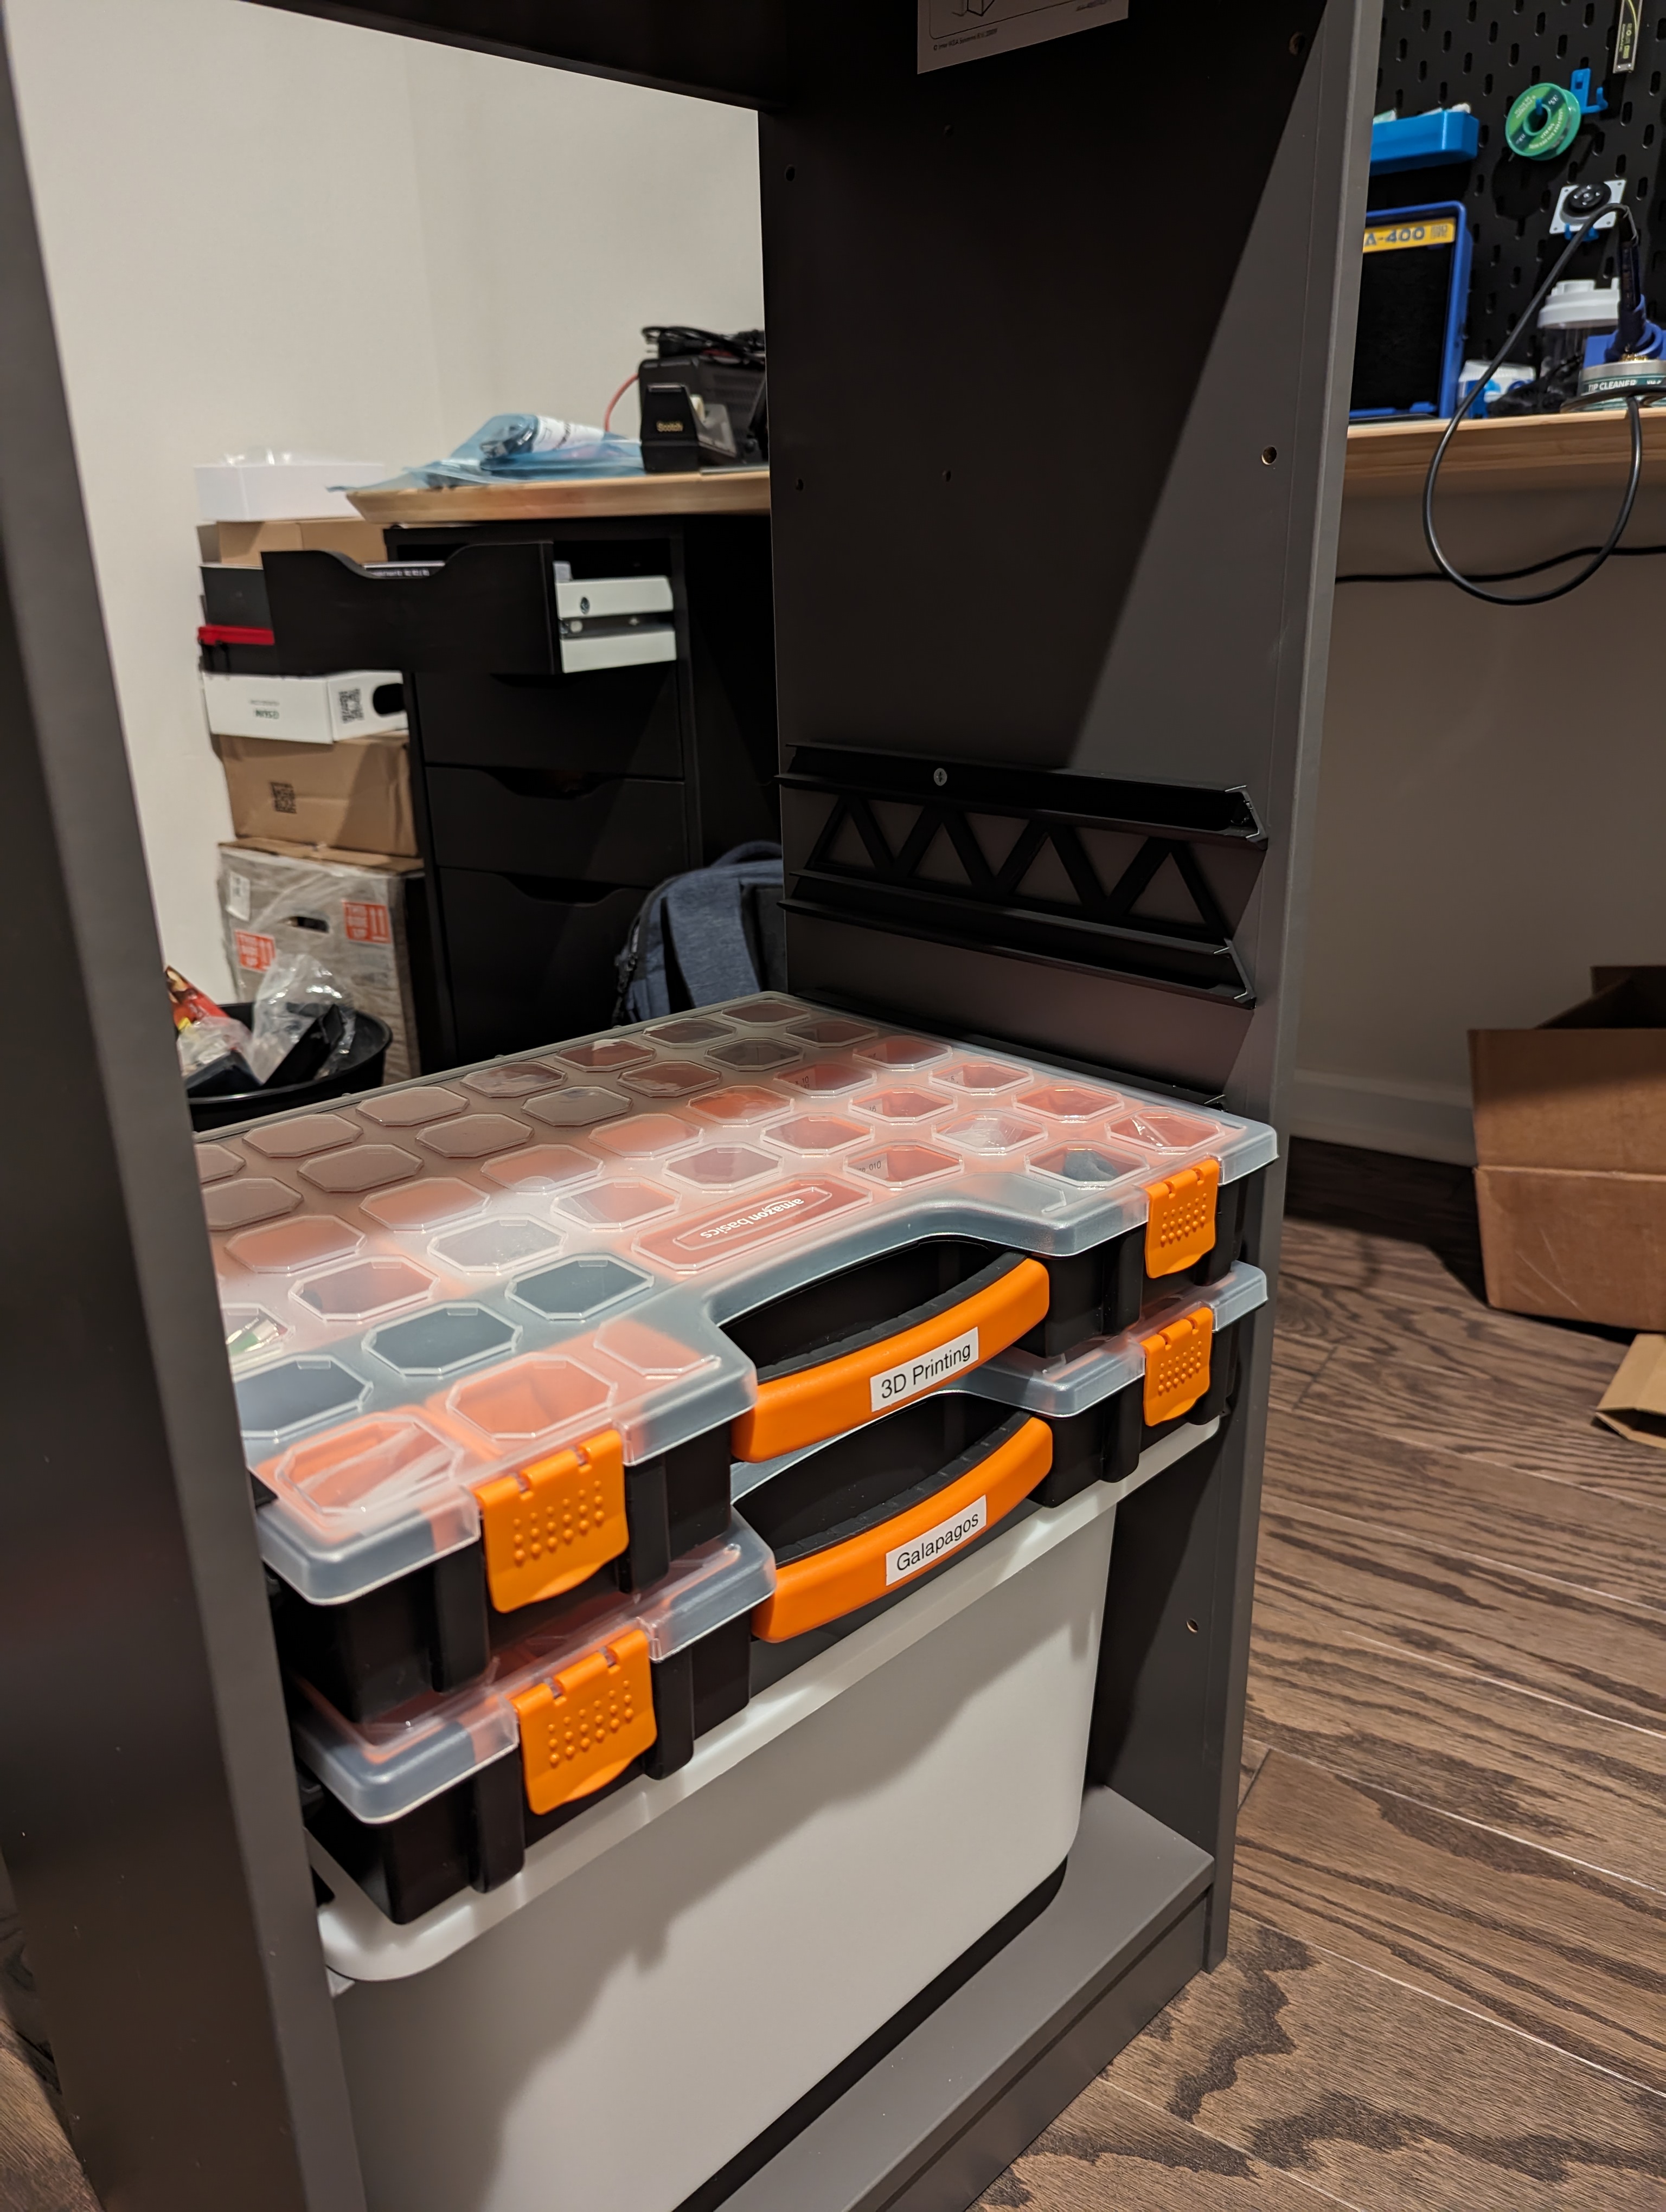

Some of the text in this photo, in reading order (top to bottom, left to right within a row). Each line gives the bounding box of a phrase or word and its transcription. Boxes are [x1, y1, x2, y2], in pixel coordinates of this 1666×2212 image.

[1599, 379, 1637, 390] CLEANER
[656, 421, 683, 433] Scotch
[869, 1160, 881, 1171] 010
[881, 1344, 970, 1399] 3D Printing
[896, 1514, 978, 1571] Galapagos
